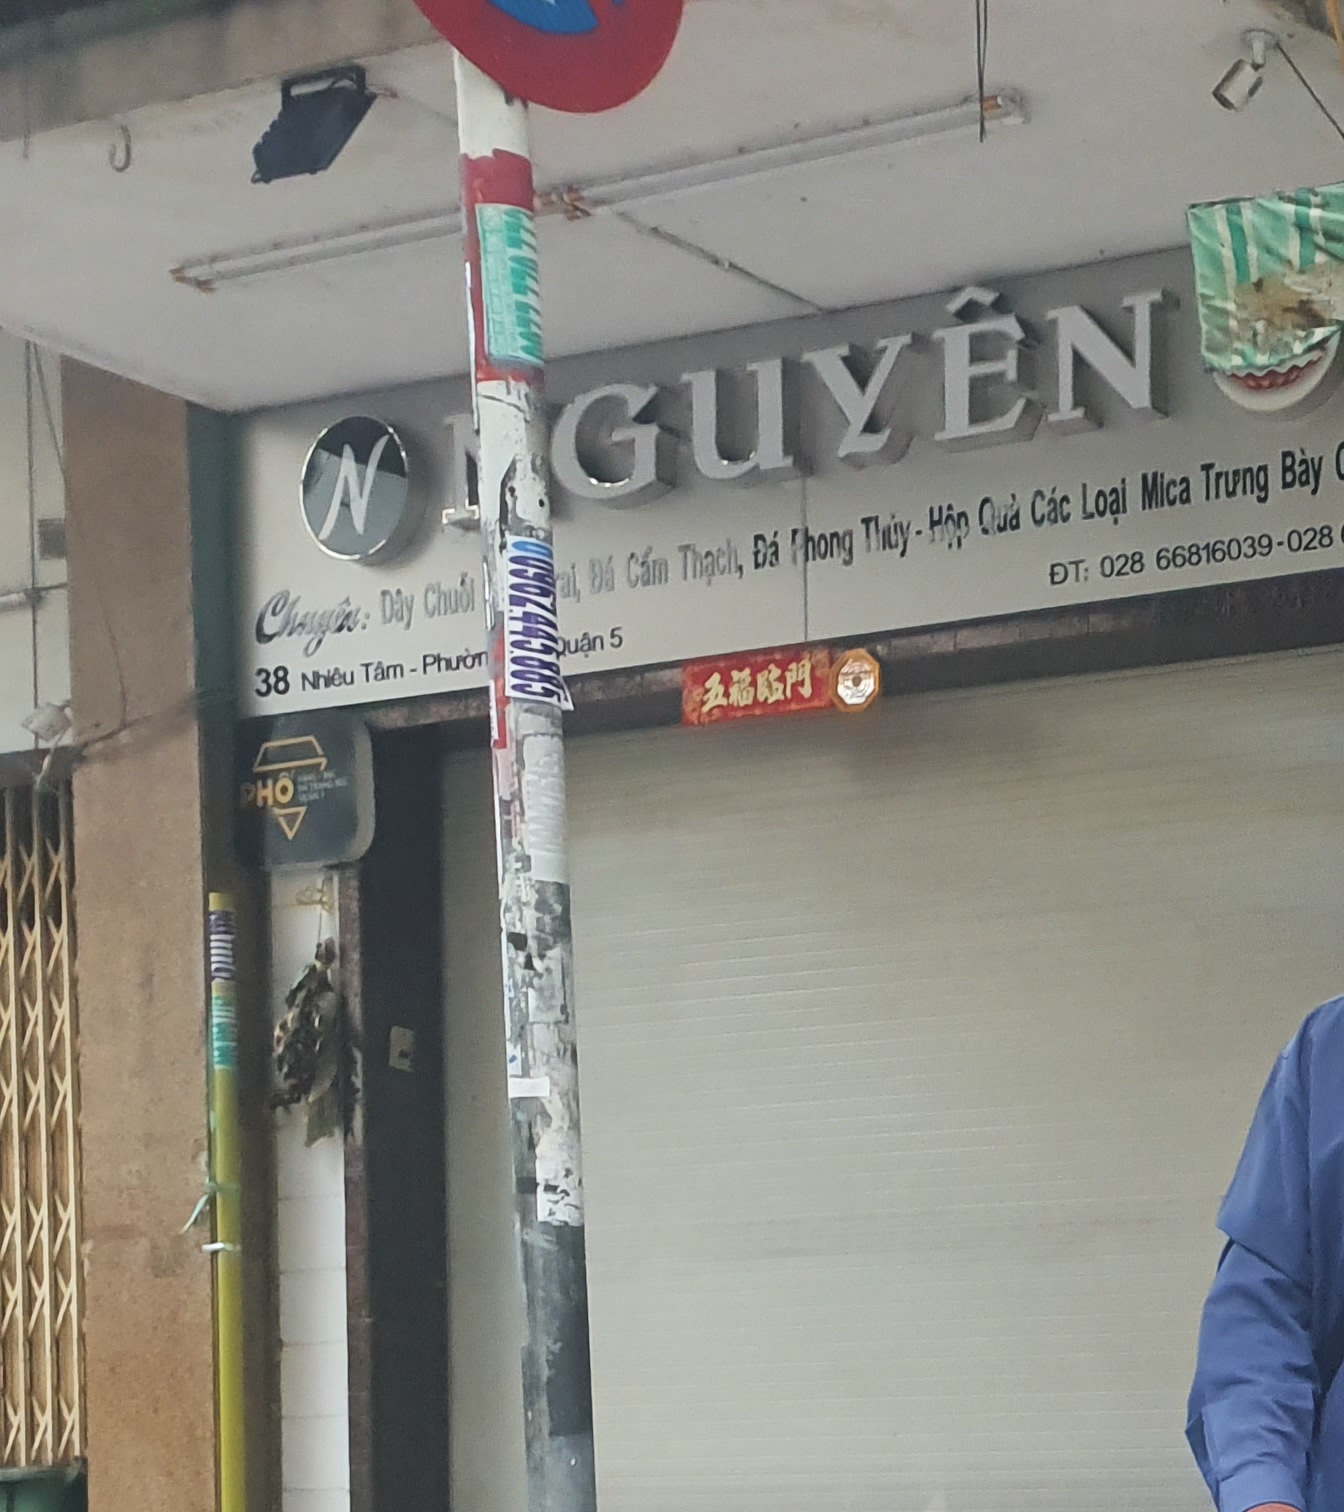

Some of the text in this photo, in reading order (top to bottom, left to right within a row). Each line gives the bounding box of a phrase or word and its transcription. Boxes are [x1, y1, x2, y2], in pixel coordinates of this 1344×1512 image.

[380, 587, 414, 631] Dây
[589, 553, 615, 594] Đá
[677, 537, 744, 588] Thạch,
[753, 530, 779, 571] Đá
[791, 524, 854, 567] Phong
[928, 502, 970, 550] Hộp
[1031, 486, 1071, 528] Các
[1081, 477, 1129, 526] Loại
[1141, 470, 1192, 511] Mica
[1200, 462, 1270, 504] Trưng
[1281, 447, 1324, 495] Bày
[1049, 558, 1089, 585] ĐT:
[1099, 550, 1145, 578] 028
[254, 665, 290, 698] 38
[360, 660, 404, 684] Tâm
[422, 648, 488, 676] Phườn
[610, 626, 623, 649] 5
